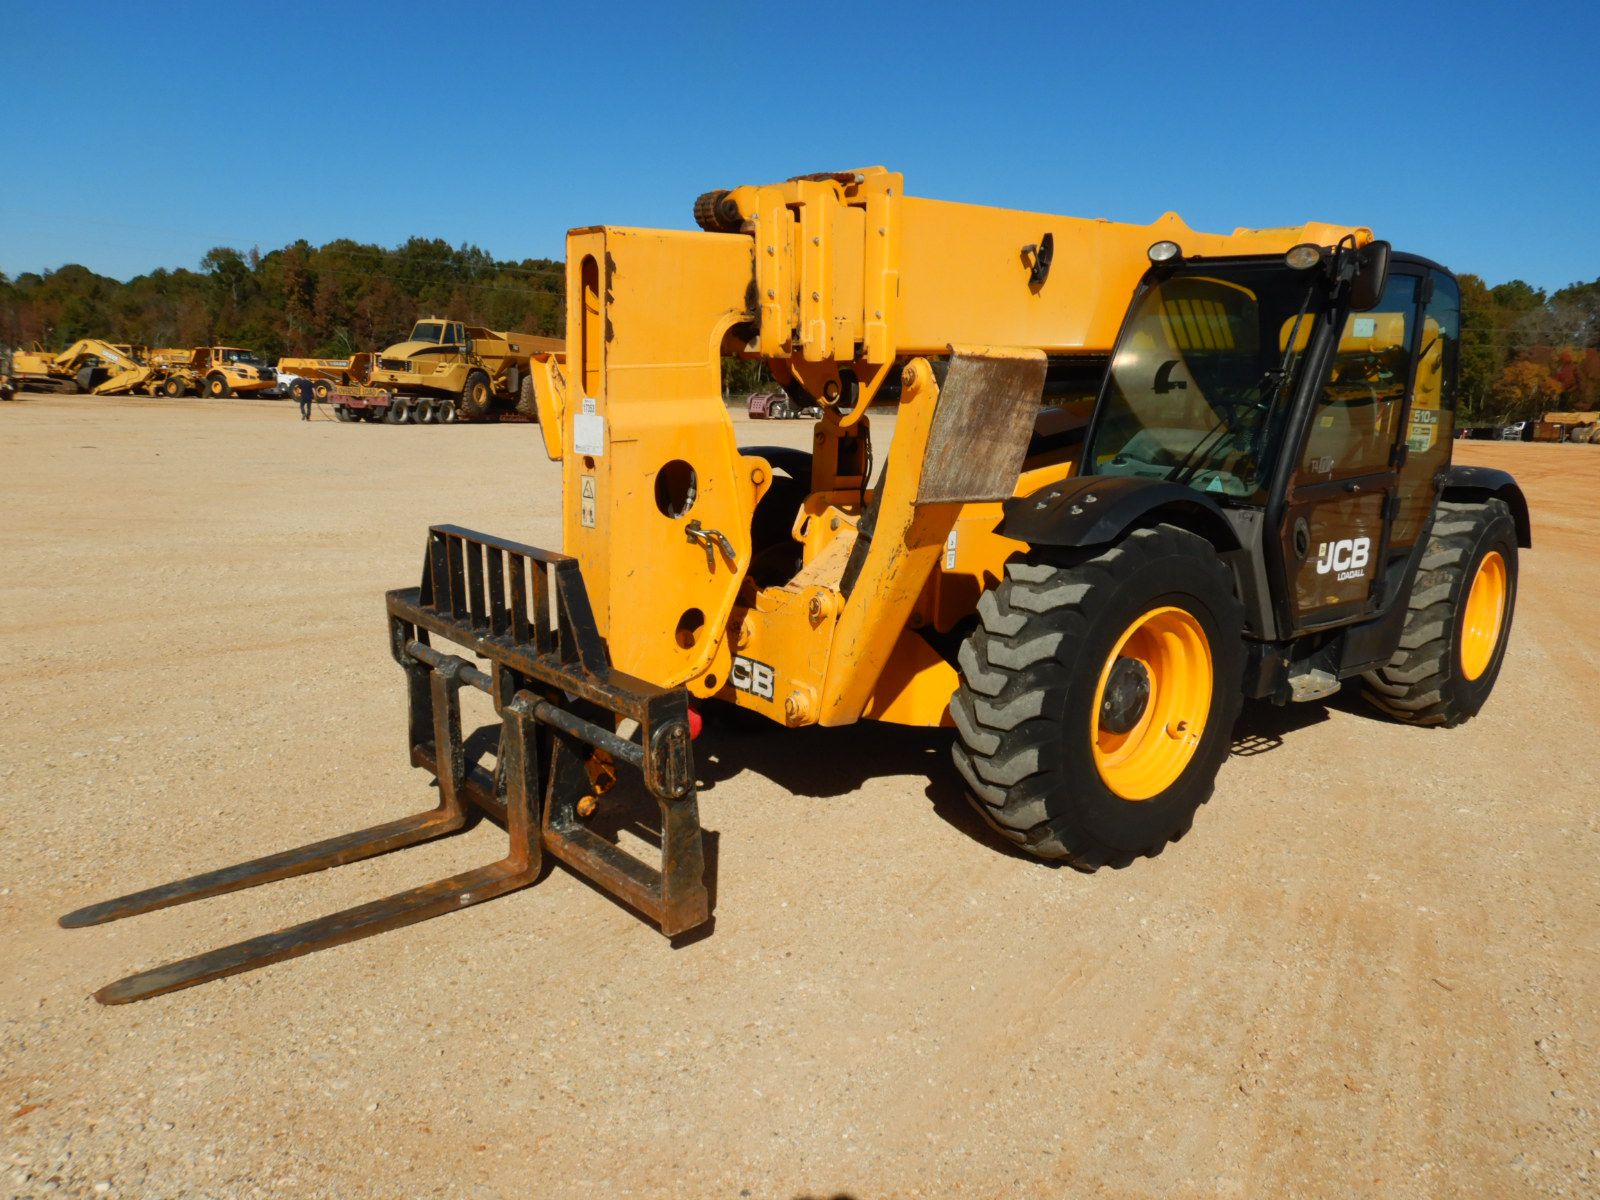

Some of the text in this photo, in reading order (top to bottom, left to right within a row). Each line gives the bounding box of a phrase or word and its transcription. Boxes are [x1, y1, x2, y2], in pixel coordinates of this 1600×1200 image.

[1317, 537, 1370, 574] JCB
[1337, 569, 1365, 581] LOADALL
[731, 656, 773, 698] CB
